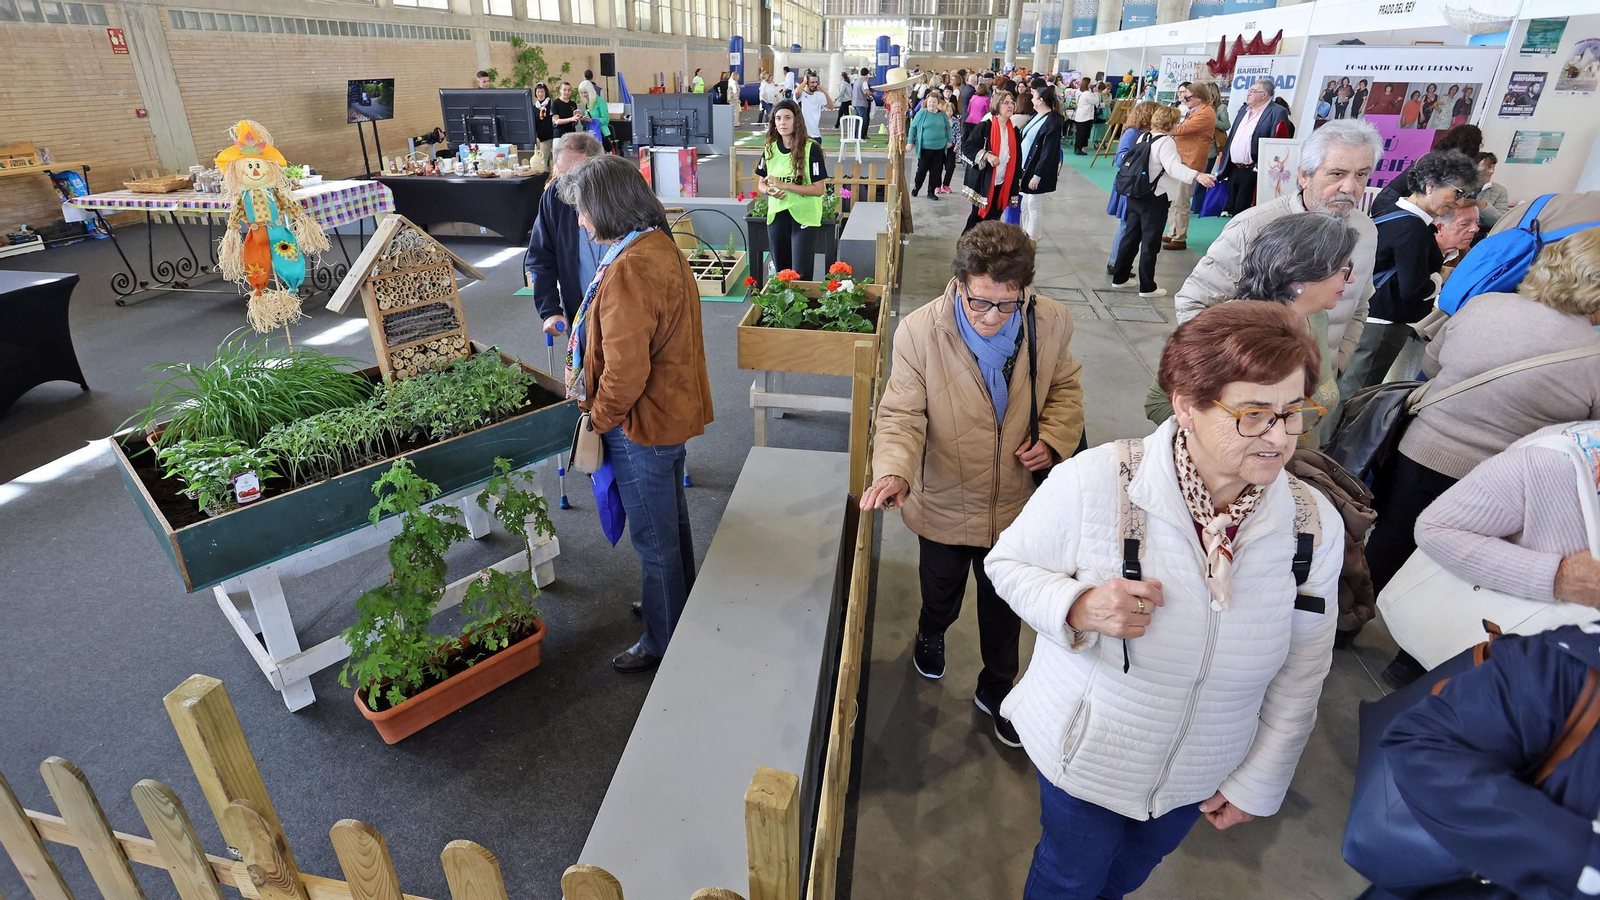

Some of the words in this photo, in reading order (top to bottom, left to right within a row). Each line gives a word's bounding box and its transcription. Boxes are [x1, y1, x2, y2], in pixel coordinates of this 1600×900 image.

[1378, 4, 1395, 15] PRADO
[1394, 3, 1404, 14] DEL
[1404, 1, 1416, 13] REY
[1237, 67, 1269, 75] BARBATE
[1427, 64, 1474, 72] PRESENTA:
